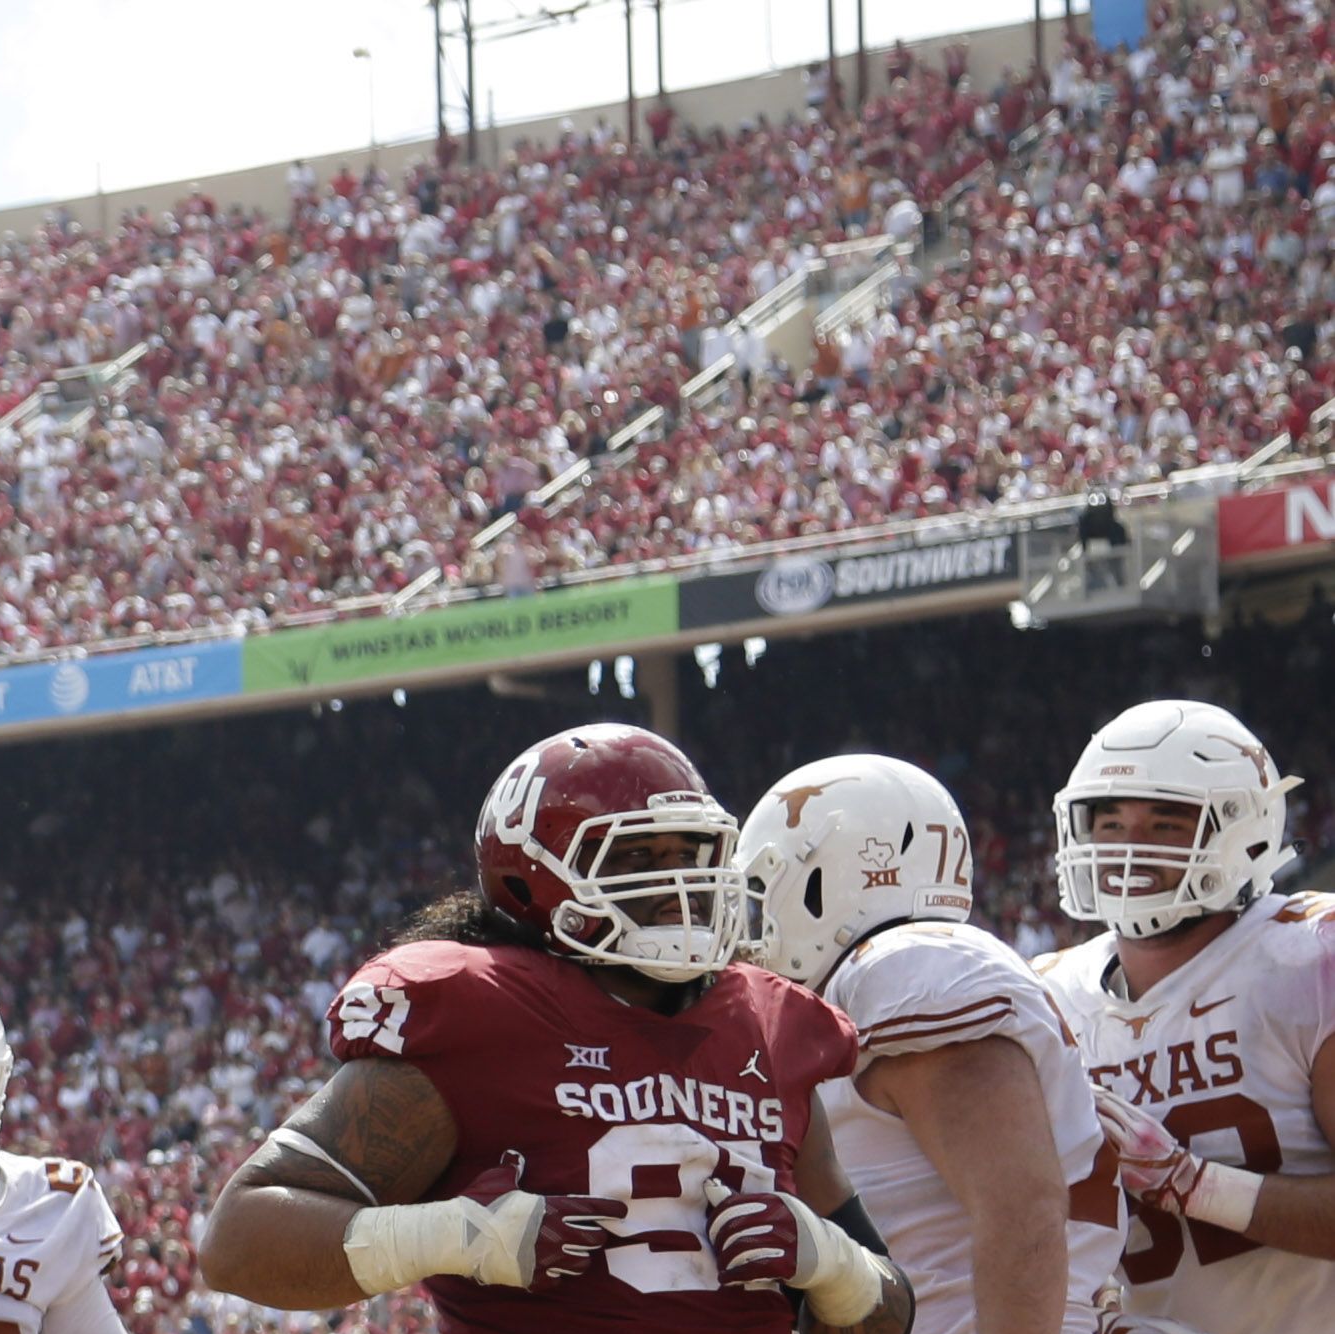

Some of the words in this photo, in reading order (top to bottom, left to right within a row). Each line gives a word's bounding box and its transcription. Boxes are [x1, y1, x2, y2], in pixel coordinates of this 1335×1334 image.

[834, 537, 1011, 597] SOUTHWEST
[333, 628, 437, 661] WINSTAR
[445, 614, 532, 644] WORLD
[539, 600, 630, 632] RESORT
[130, 656, 198, 695] AT&T
[493, 752, 544, 844] OU
[926, 824, 968, 886] 72
[564, 1043, 610, 1071] XII
[555, 1074, 784, 1142] SOONERS
